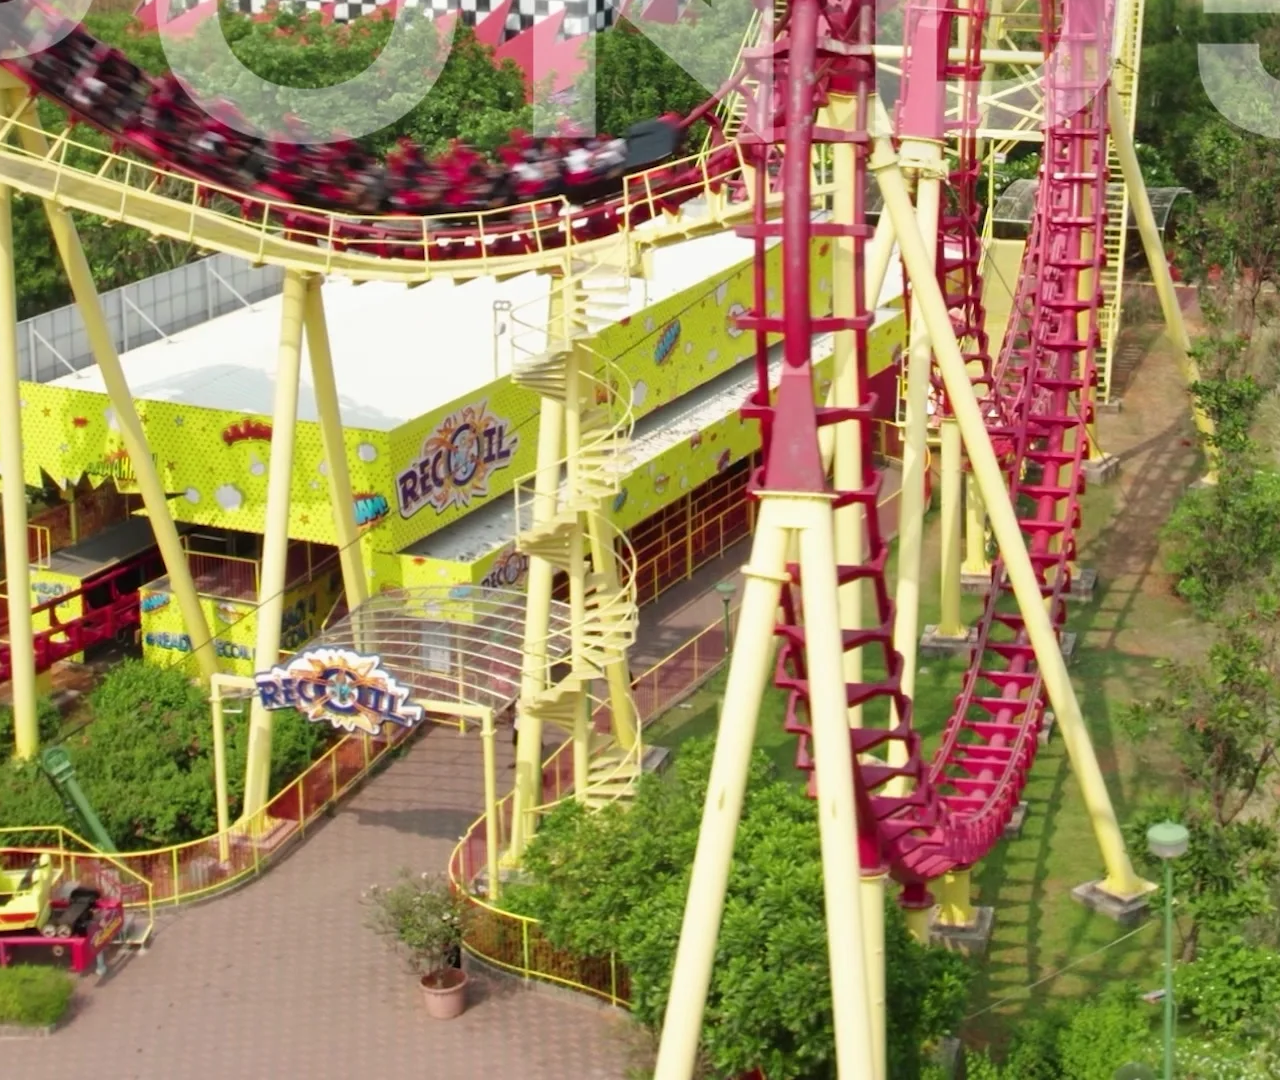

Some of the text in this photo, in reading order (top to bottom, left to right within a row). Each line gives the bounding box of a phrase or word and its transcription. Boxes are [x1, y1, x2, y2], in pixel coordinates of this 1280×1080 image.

[399, 422, 519, 511] RECOIL
[480, 552, 529, 598] RECOI
[256, 667, 411, 728] RECOIL
